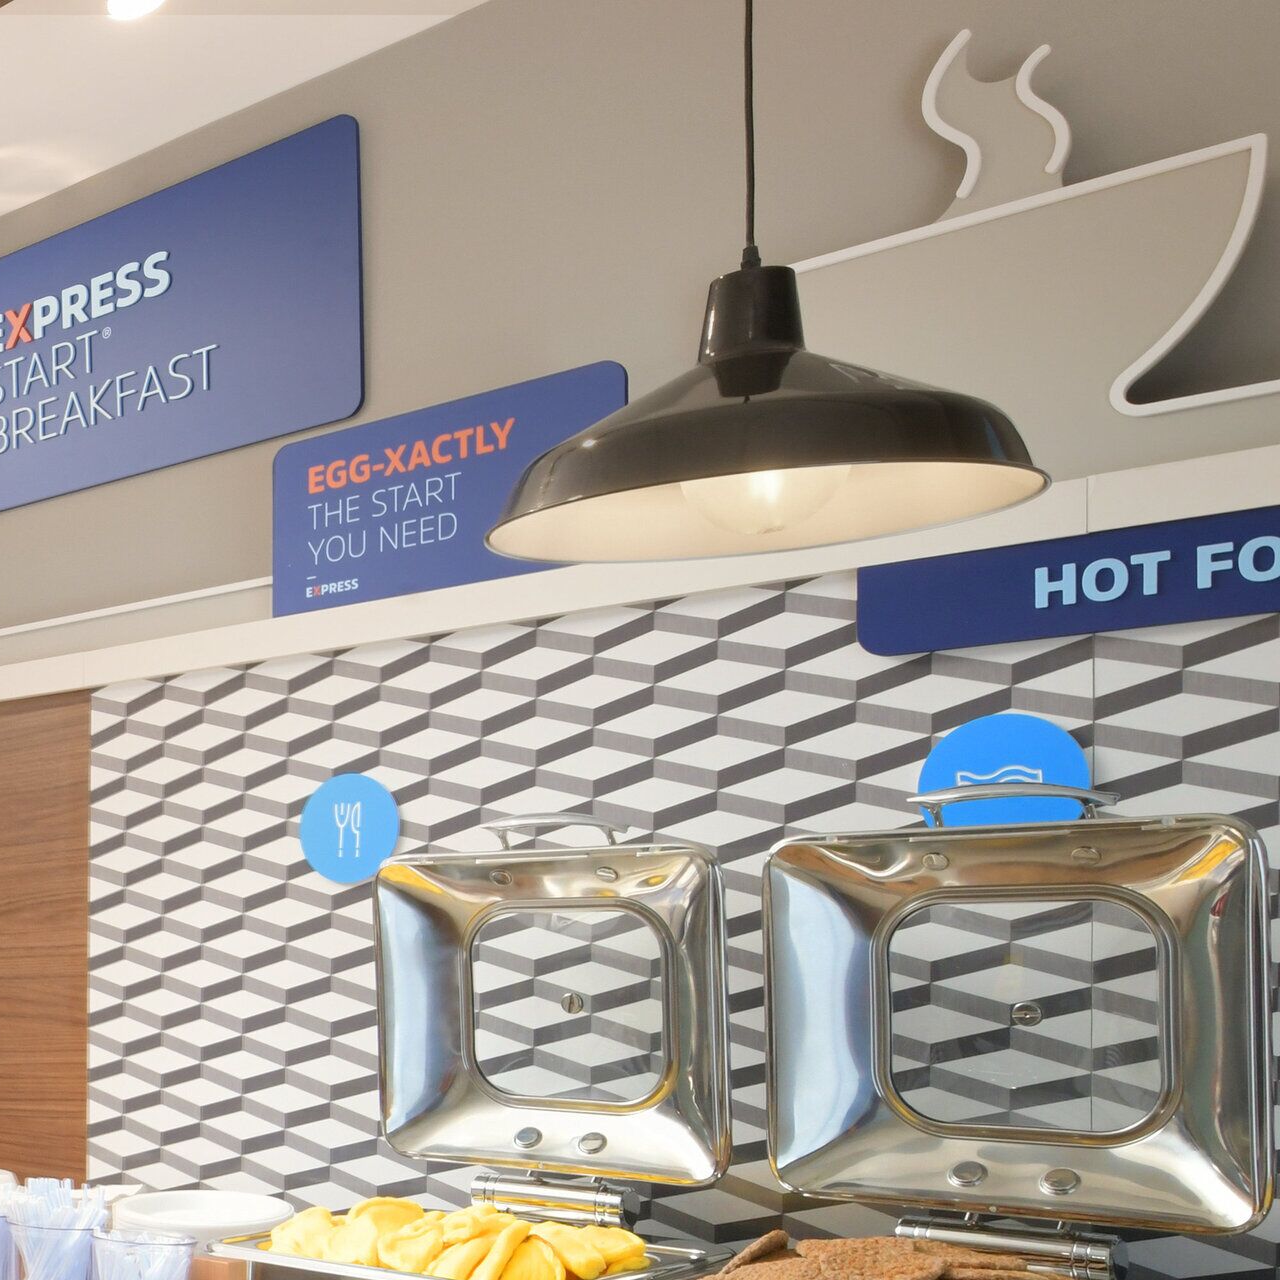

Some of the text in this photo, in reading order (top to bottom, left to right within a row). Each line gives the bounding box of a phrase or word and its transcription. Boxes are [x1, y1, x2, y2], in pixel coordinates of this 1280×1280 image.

[307, 417, 515, 494] EGG-XACTLY
[308, 472, 462, 530] THE START
[308, 512, 457, 565] YOU NEED
[306, 578, 359, 598] EXPRESS
[1034, 535, 1280, 609] HOT FO
